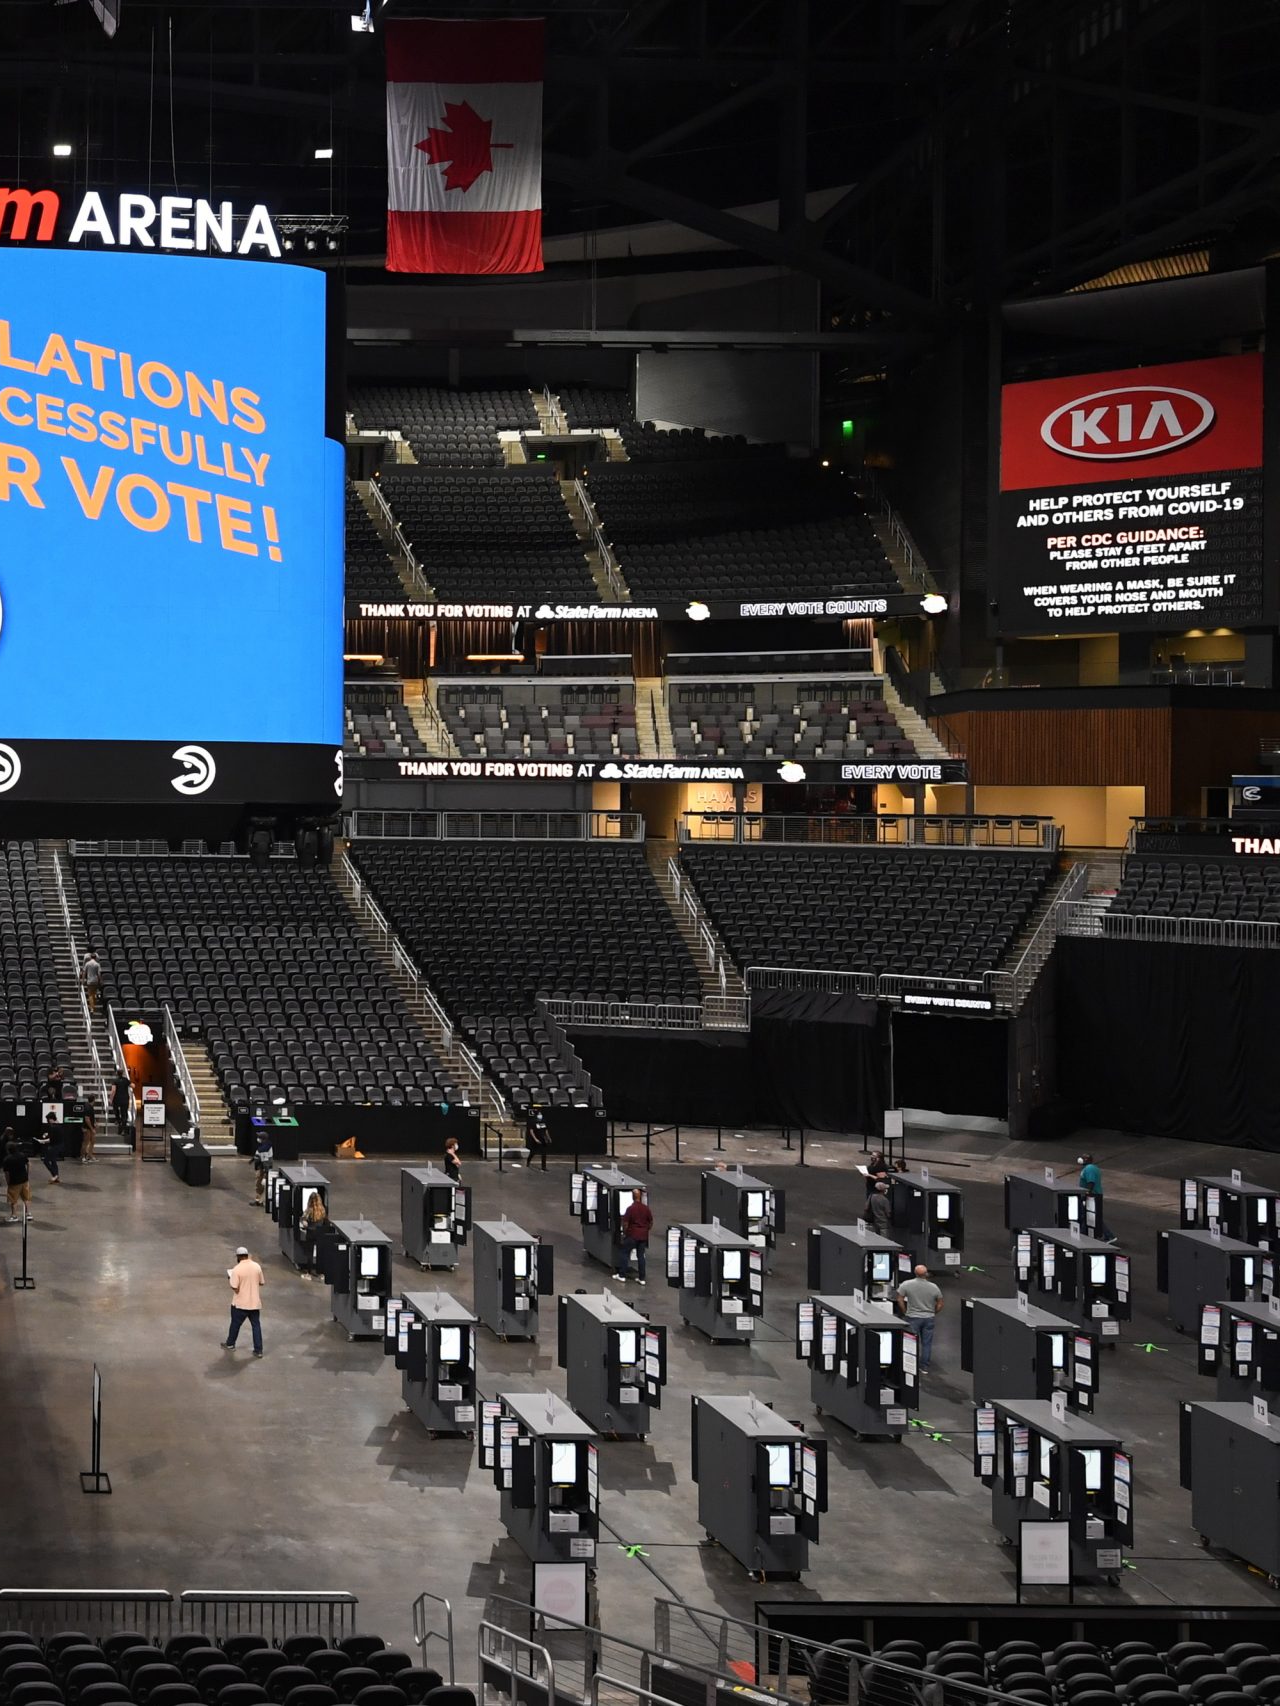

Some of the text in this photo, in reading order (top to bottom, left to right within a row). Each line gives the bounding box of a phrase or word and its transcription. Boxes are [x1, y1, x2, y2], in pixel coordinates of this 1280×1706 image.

[69, 192, 281, 257] ARENA
[1070, 399, 1184, 448] KIA
[61, 452, 282, 562] VOTE!
[1029, 482, 1232, 512] HELP PROTECT YOURSELF
[1017, 498, 1243, 527] AND OTHERS FROM COVID-19
[1046, 525, 1205, 549] PER CDC GUIDANCE:
[1049, 540, 1207, 561] PLEASE STAY 6 FEET APART
[1065, 553, 1190, 571] FROM OTHER PEOPLE
[1023, 574, 1236, 597] WHEN WEARING A MASK, BE SURE IT
[740, 599, 887, 616] EVERY VOTE COUNTS
[1034, 586, 1223, 608] COVERS YOUR NOSE AND MOUTH
[360, 604, 405, 616] THANK
[407, 605, 434, 617] YOU
[437, 605, 463, 617] FOR
[465, 605, 513, 617] VOTING
[517, 606, 532, 617] AT
[621, 608, 658, 618] ARENA
[1047, 600, 1205, 618] TO HELP PROTECT OTHERS.
[399, 762, 448, 775] THANK
[450, 763, 481, 776] YOU
[485, 763, 515, 776] FOR
[517, 763, 573, 777] VOTING
[578, 764, 595, 777] AT
[701, 768, 744, 778] ARENA
[842, 765, 942, 779] EVERY VOTE
[697, 790, 758, 803] HAWS
